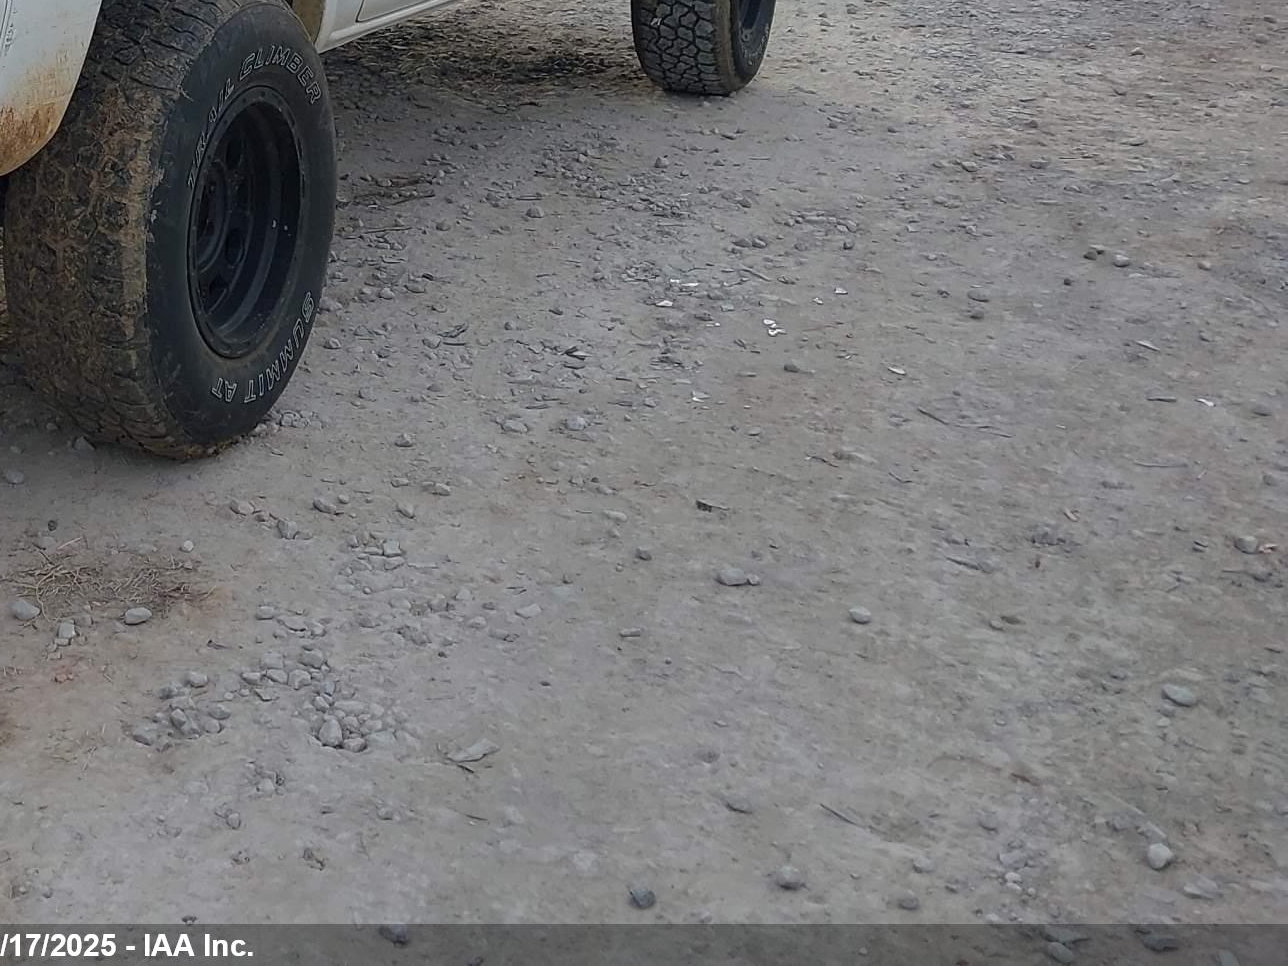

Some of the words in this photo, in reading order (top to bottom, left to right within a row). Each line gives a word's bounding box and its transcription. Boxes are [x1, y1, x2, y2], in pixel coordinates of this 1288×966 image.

[239, 44, 321, 105] CLIMBER
[243, 291, 315, 404] SUMMIT
[211, 377, 238, 403] AT
